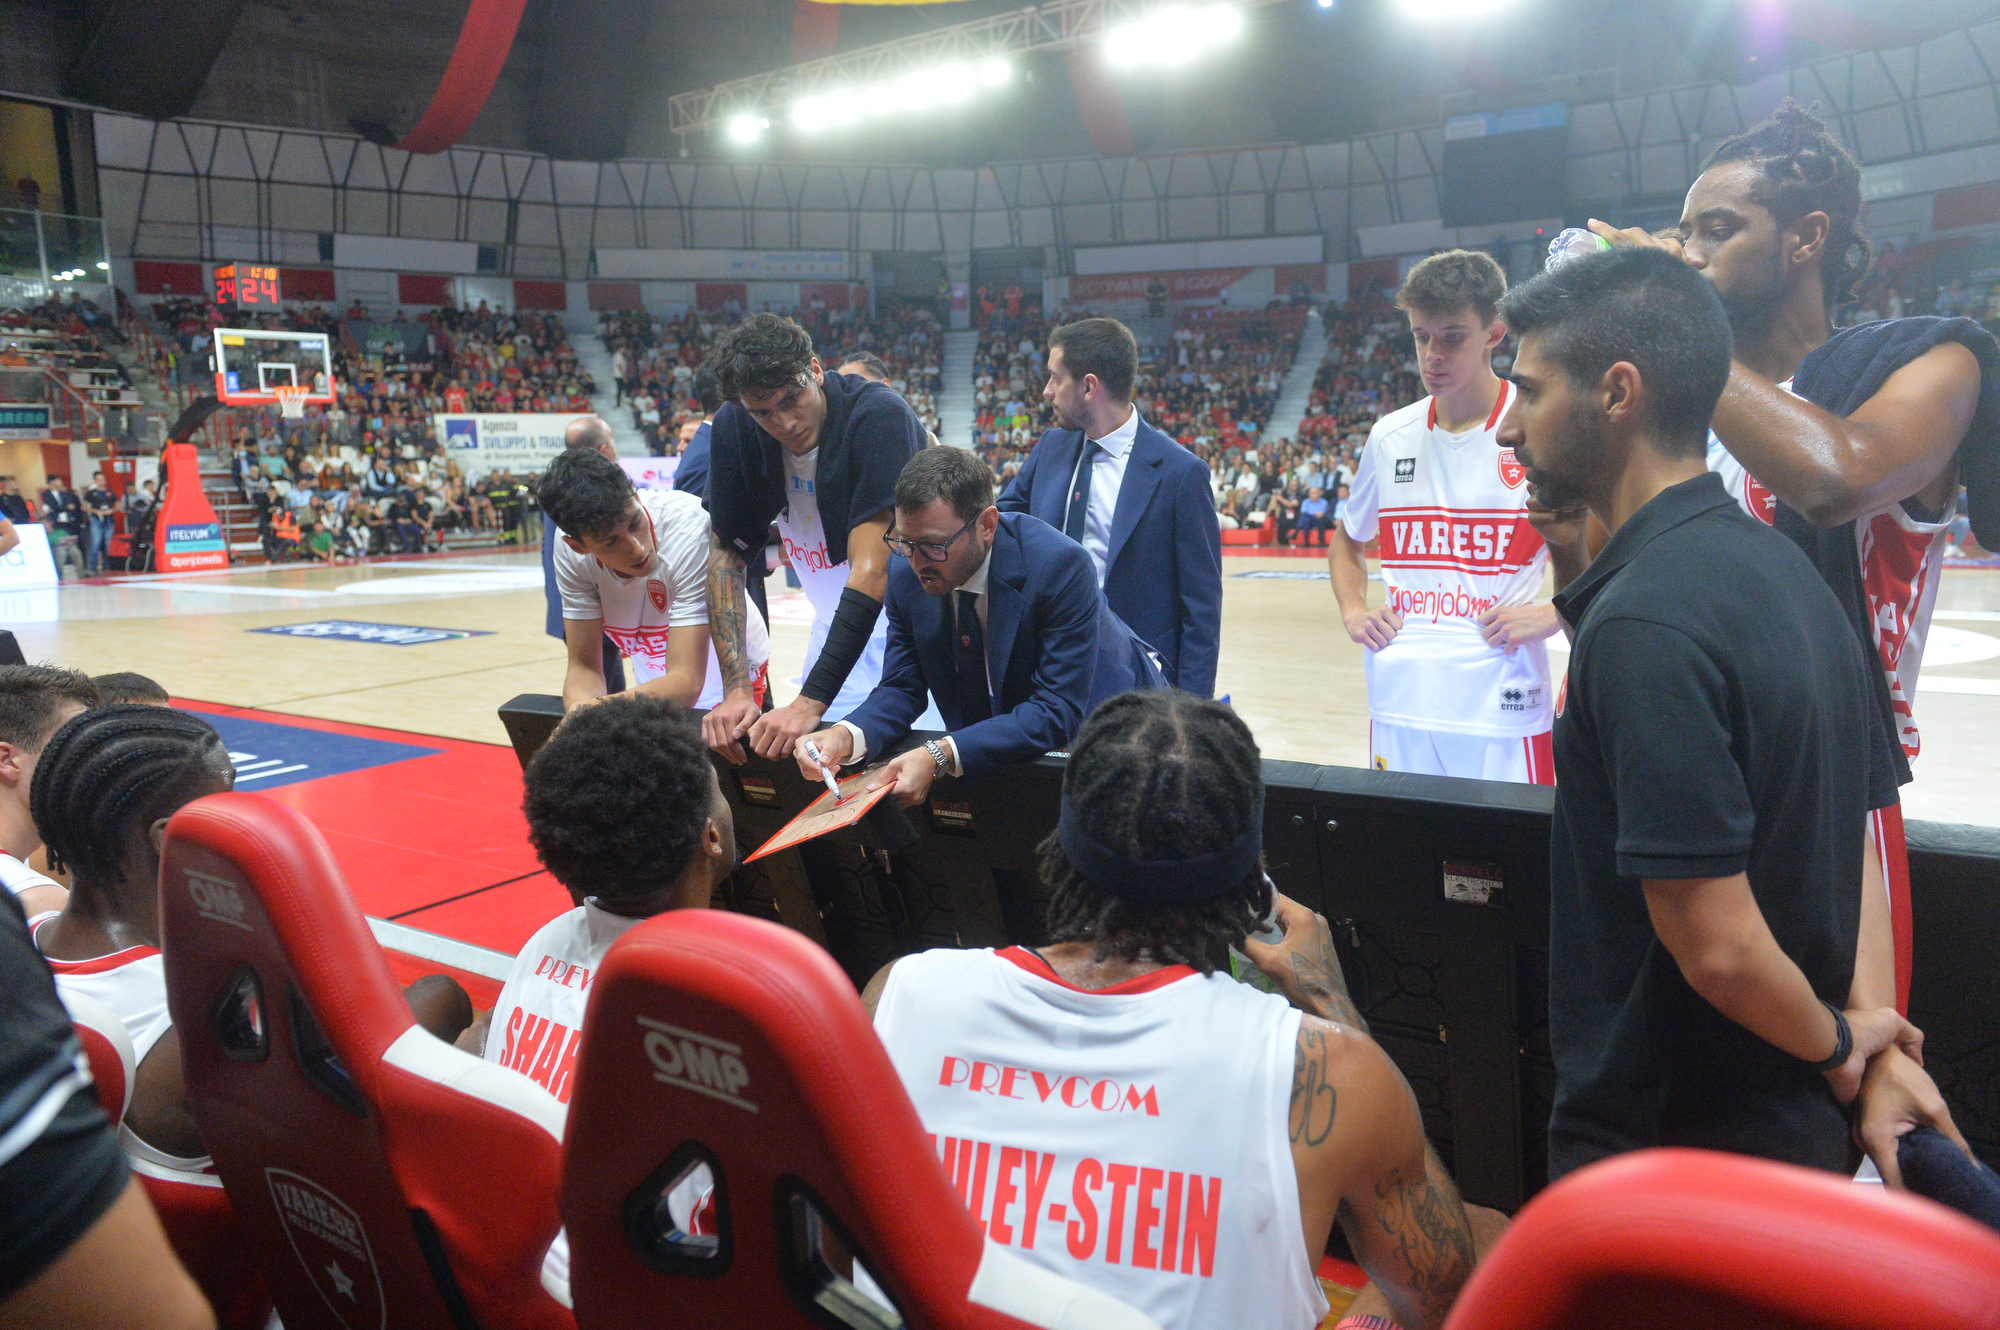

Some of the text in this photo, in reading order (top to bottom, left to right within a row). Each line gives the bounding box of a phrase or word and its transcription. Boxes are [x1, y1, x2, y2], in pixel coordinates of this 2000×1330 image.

[216, 279, 237, 304] 24
[241, 278, 278, 304] 24
[482, 420, 518, 433] Agenzia
[484, 436, 527, 449] SVILUPPO
[530, 437, 536, 449] &
[169, 528, 208, 541] ITELYUM
[1501, 703, 1525, 711] errea
[188, 879, 246, 921] OMP
[535, 954, 597, 992] PREV
[644, 1031, 750, 1094] OMP
[939, 1056, 1160, 1117] PREVCOM
[275, 1182, 362, 1248] VARESE
